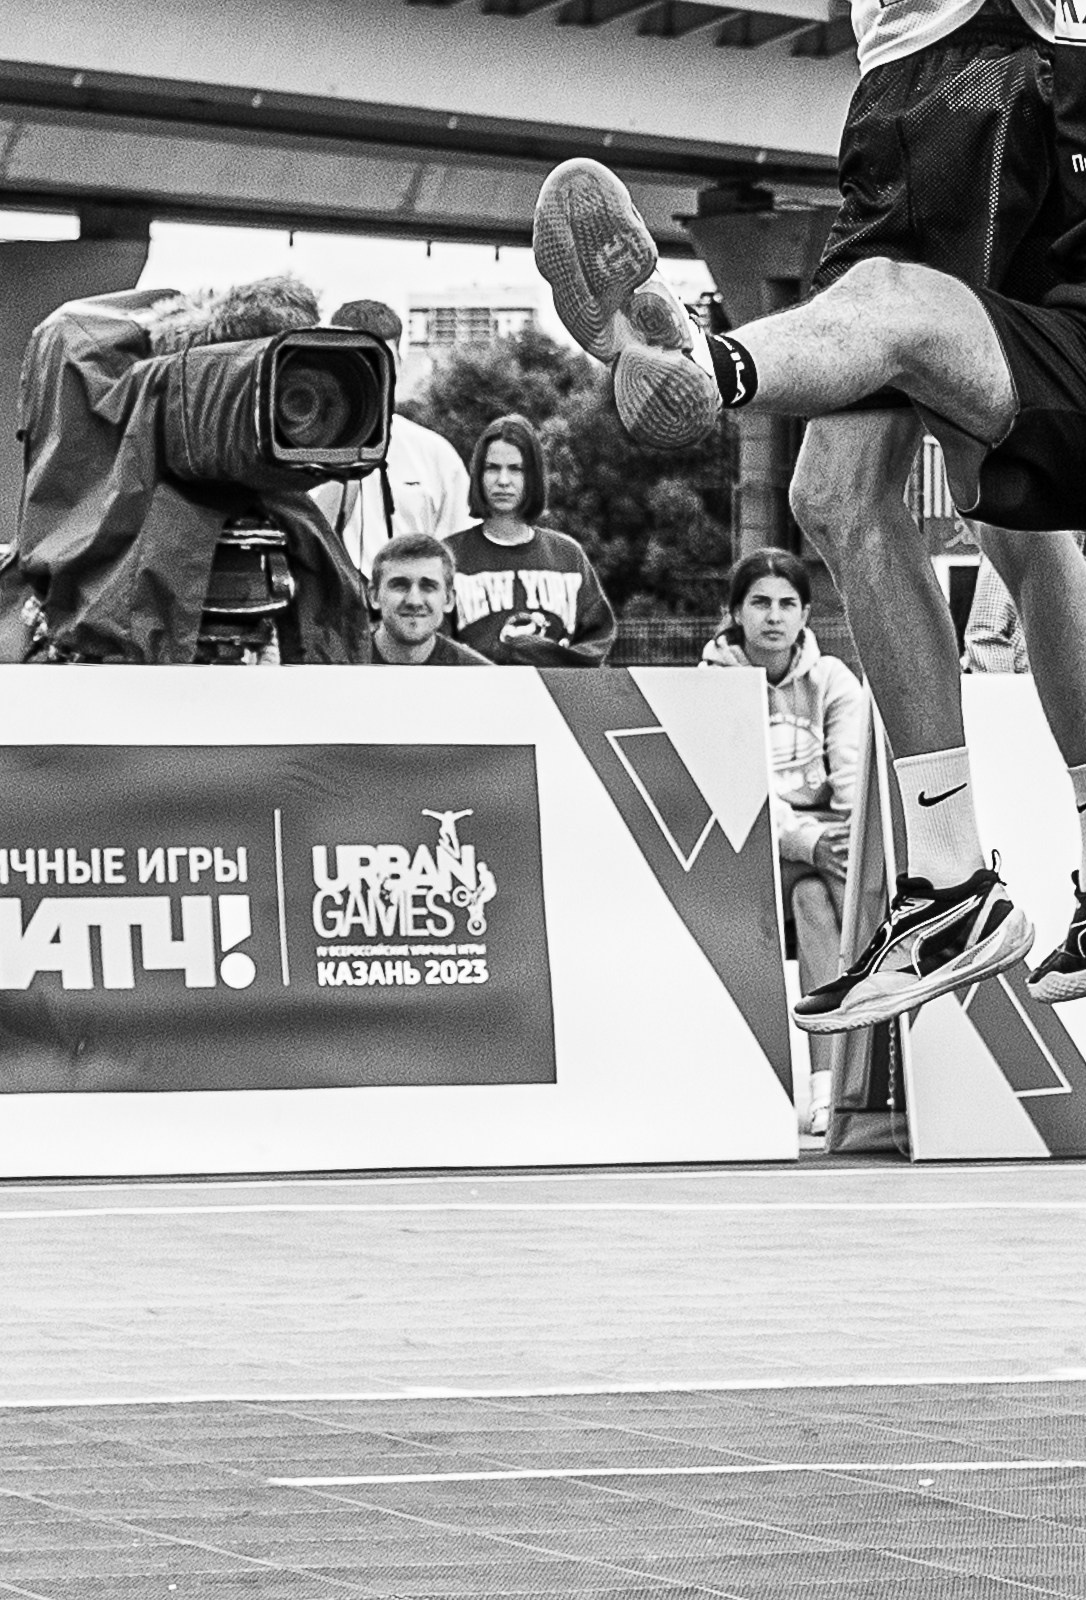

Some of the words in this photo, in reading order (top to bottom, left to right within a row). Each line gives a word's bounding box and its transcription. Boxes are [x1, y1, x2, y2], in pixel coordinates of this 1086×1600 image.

[137, 846, 249, 883] ИГРЫ
[312, 844, 476, 893] URBAN
[312, 889, 455, 938] GAMES
[316, 960, 421, 986] КАЗАНЬ
[424, 959, 489, 985] 2023
